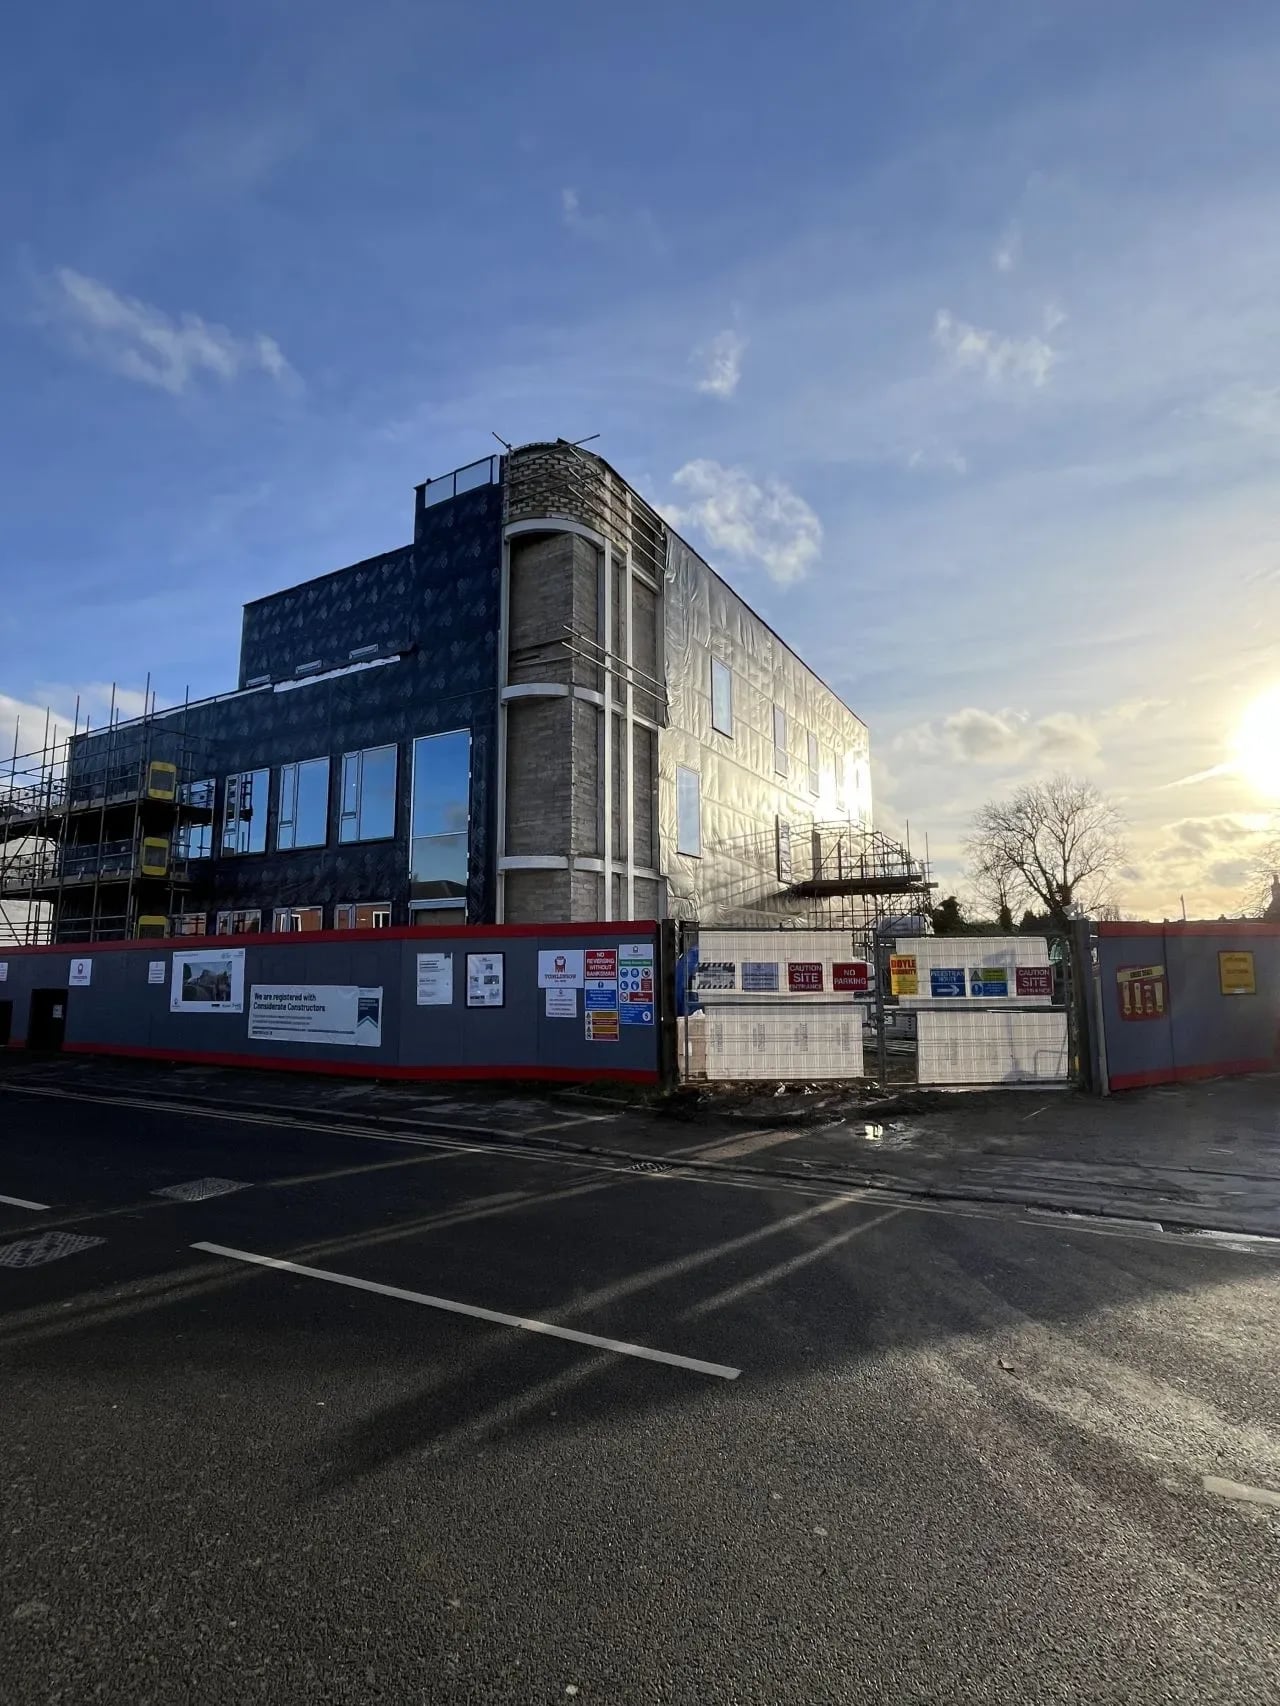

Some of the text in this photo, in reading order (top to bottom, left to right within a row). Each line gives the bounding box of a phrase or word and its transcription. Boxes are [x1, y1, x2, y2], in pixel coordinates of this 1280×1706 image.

[793, 973, 819, 983] SITE
[834, 977, 867, 985] PARKING
[1022, 977, 1048, 987] SITE
[254, 993, 262, 1001] We
[273, 993, 303, 1002] registered
[303, 993, 317, 1001] with
[253, 1002, 326, 1012] Considerate Constructors
